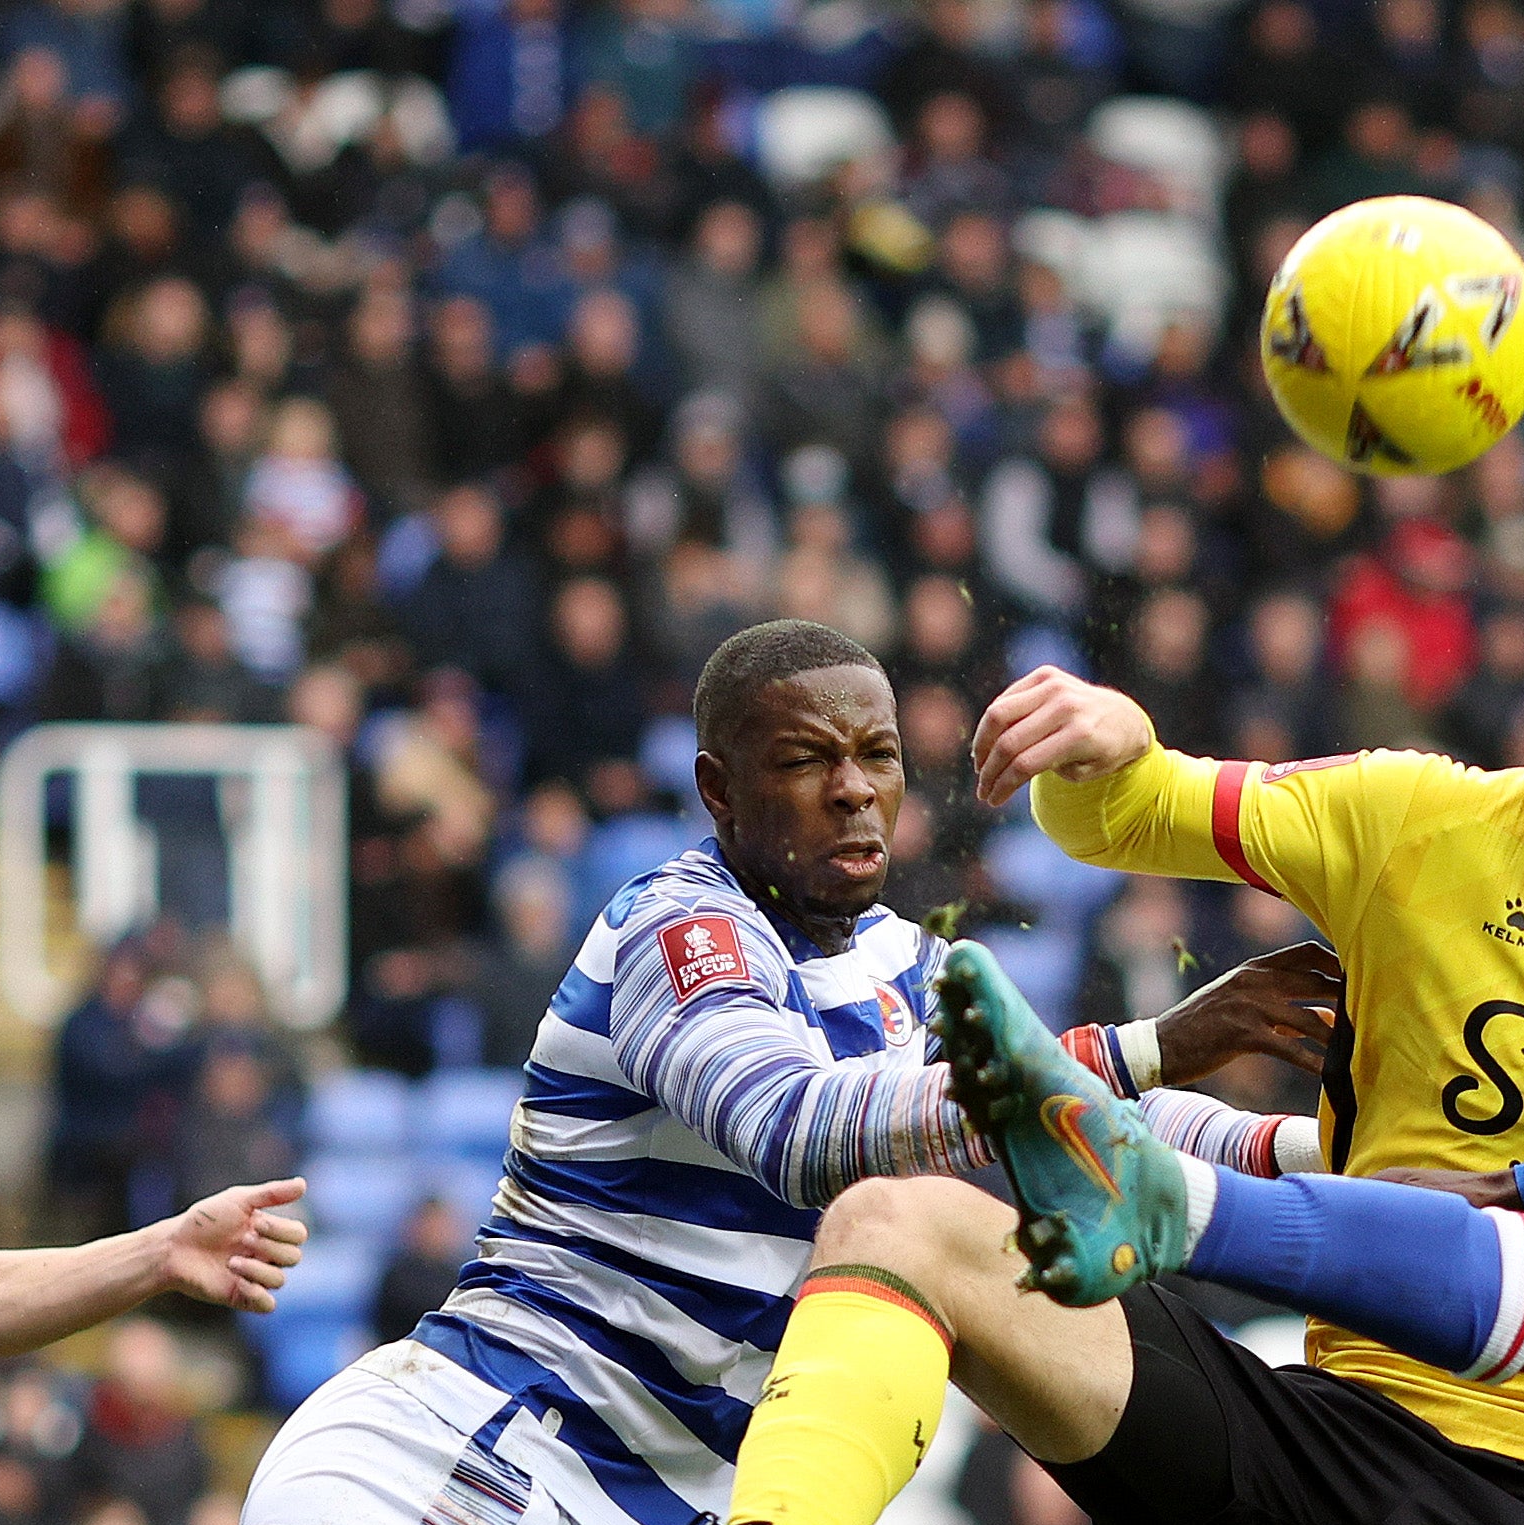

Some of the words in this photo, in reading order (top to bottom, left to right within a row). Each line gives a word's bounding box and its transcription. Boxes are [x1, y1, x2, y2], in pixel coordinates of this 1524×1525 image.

[678, 953, 734, 978] Emirates
[681, 970, 702, 989] FA
[700, 961, 737, 977] CUP
